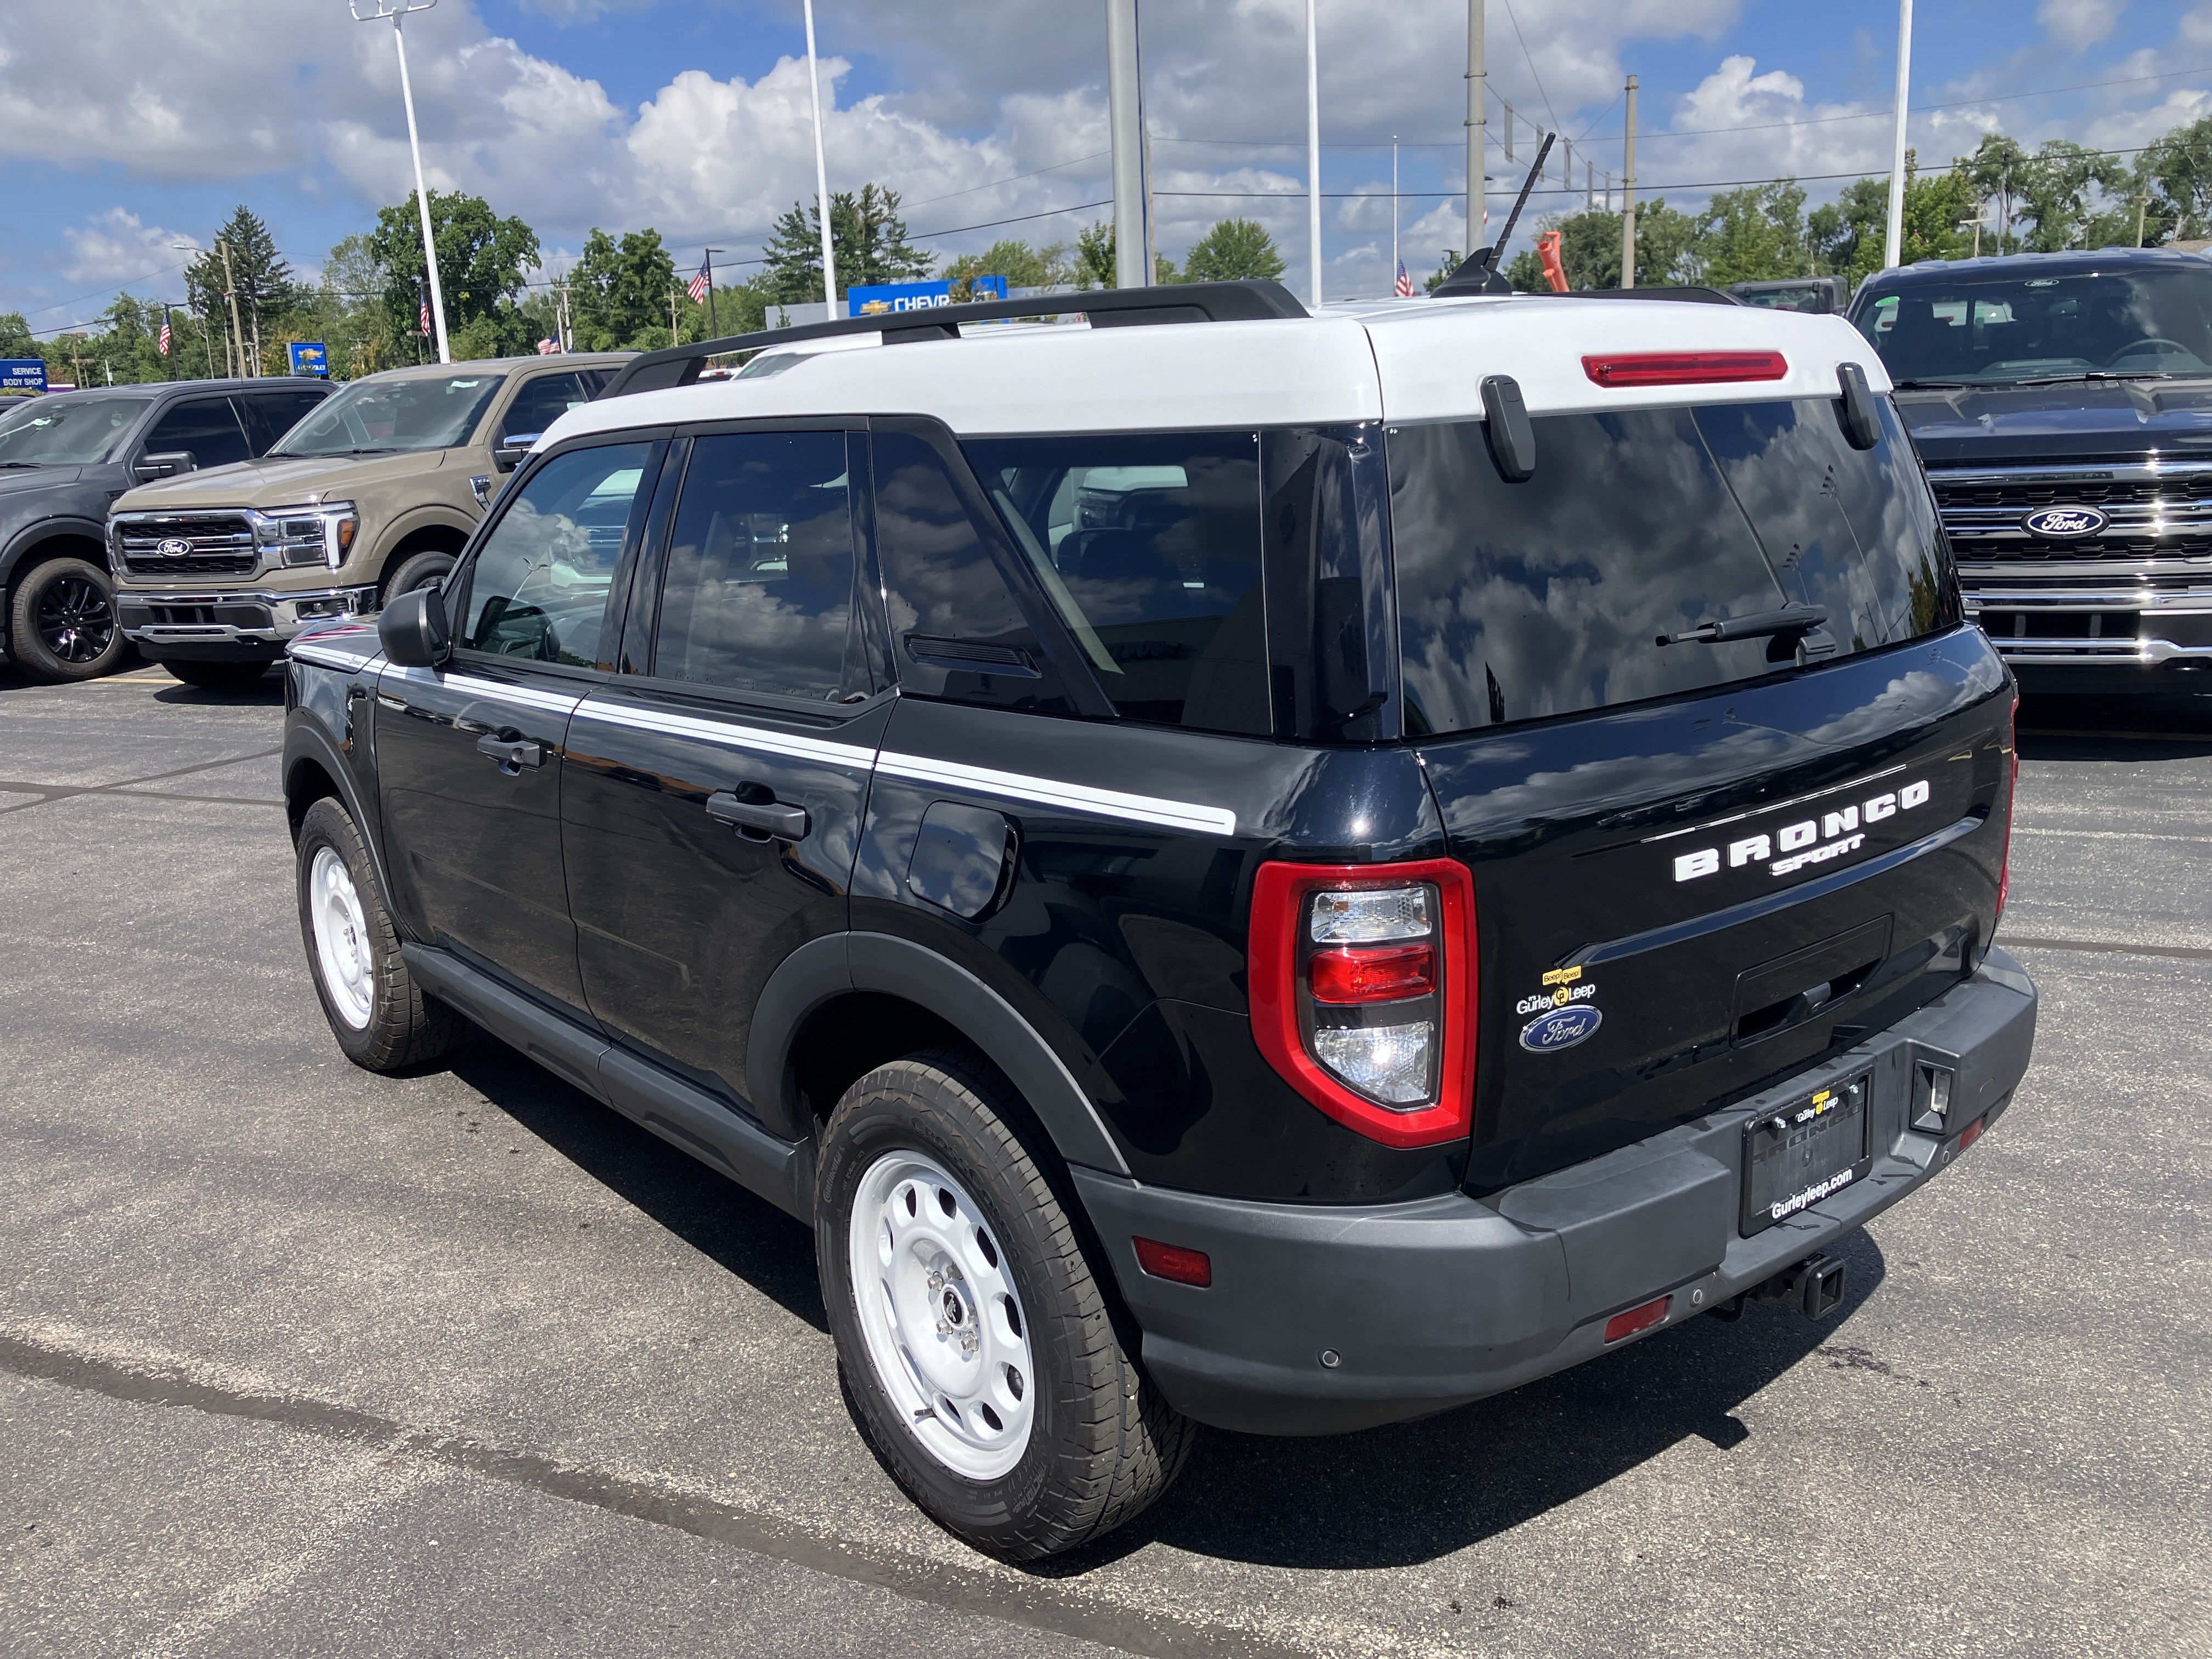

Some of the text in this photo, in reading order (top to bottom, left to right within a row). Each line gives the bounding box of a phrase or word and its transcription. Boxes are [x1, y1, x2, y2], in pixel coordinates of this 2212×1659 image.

[24, 377, 43, 386] SHOP
[2041, 512, 2089, 530] Ford
[163, 541, 183, 553] Ford
[1673, 780, 1929, 882] BRONCO
[1769, 833, 1865, 877] SPORT
[1544, 969, 1580, 983] Beep! Beep!
[1516, 994, 1555, 1014] Gurley
[1568, 984, 1595, 1001] Leep
[1542, 1015, 1587, 1045] Ford
[1823, 1097, 1838, 1111] Leep
[1772, 1169, 1852, 1219] Gurleyleep.com
